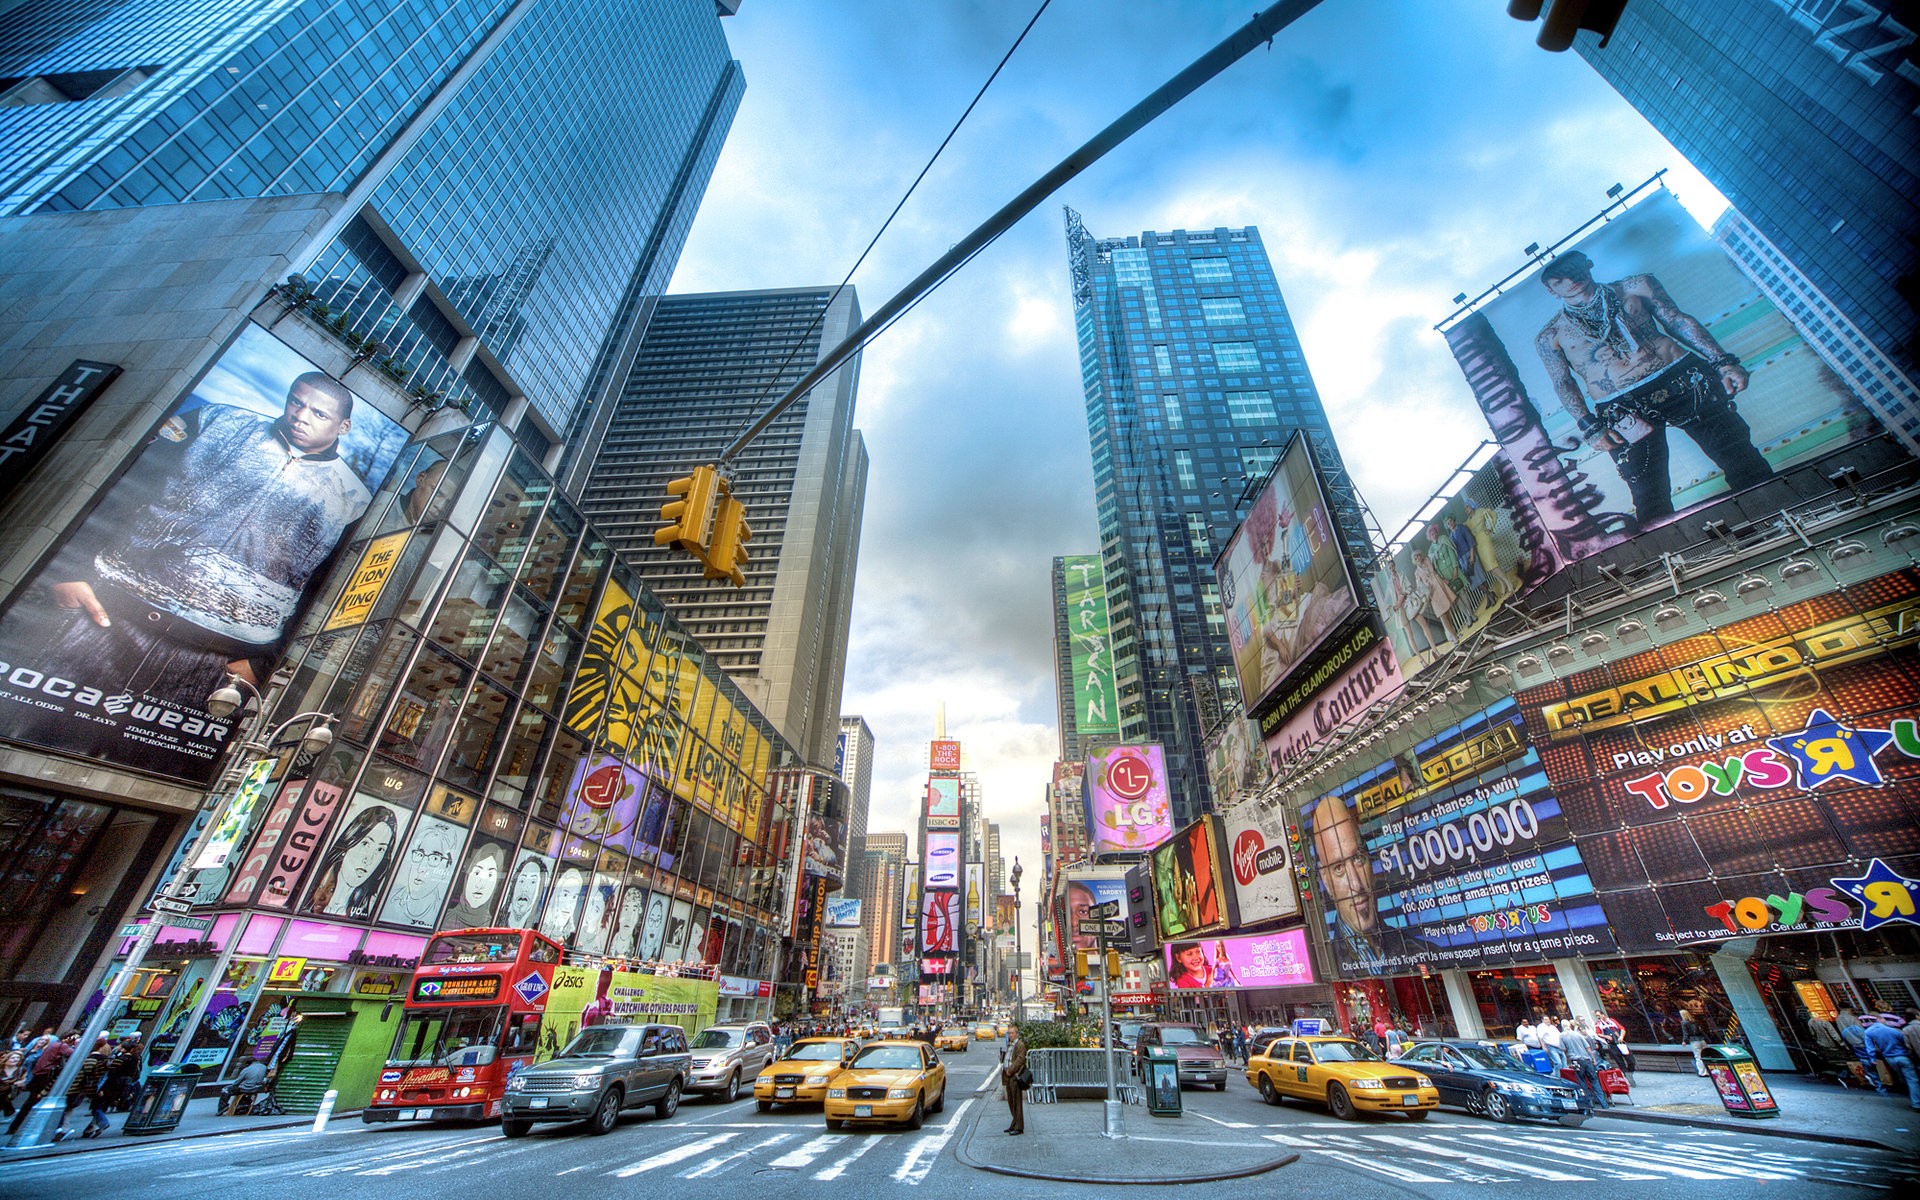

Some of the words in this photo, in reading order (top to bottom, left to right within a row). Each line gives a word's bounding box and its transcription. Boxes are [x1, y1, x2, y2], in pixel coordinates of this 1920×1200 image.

[370, 550, 393, 565] THE
[350, 567, 388, 592] LION
[336, 590, 375, 617] KING
[1070, 564, 1108, 723] TARZAN
[1262, 707, 1280, 733] BORN
[1279, 701, 1289, 717] IN
[1287, 690, 1302, 709] THE
[1301, 644, 1353, 697] GLAMOROUS
[1352, 626, 1374, 652] USA
[1313, 647, 1397, 737] Couture
[1554, 668, 1688, 731] DEAL
[1686, 664, 1716, 703] OR
[1706, 646, 1803, 690] NO
[11, 694, 34, 705] ALL
[35, 700, 65, 713] ODDS
[73, 710, 92, 720] DR.
[93, 716, 118, 727] JAYS
[125, 725, 158, 737] JIMMY
[157, 733, 179, 744] JAZZ
[186, 741, 218, 753] MACY'S
[143, 694, 158, 703] WE
[159, 700, 182, 711] RUN
[183, 706, 204, 717] THE
[204, 713, 234, 725] STRIP
[123, 732, 214, 760] WWW.ROCAWEAR.COM
[721, 720, 742, 753] THE
[1449, 727, 1518, 772] DEAL
[1612, 747, 1668, 770] Play
[1669, 732, 1723, 757] only
[1730, 723, 1759, 743] at
[683, 727, 719, 785] LION
[384, 776, 403, 790] we
[1625, 748, 1792, 810] TOYS
[1114, 802, 1153, 826] LG
[1381, 818, 1404, 837] Play
[1403, 812, 1420, 828] for
[1422, 811, 1430, 822] a
[1430, 796, 1475, 818] chance
[1474, 786, 1491, 802] to
[1491, 776, 1520, 794] win
[495, 817, 508, 828] all
[233, 786, 302, 893] PEACE
[267, 788, 336, 897] PEACE
[569, 845, 591, 858] speak
[1379, 797, 1539, 881] $1,000,000
[1236, 835, 1258, 879] Virgin
[1259, 850, 1283, 871] mobile
[1399, 889, 1409, 900] or
[1416, 881, 1433, 896] trip
[1434, 879, 1445, 890] to
[1446, 876, 1462, 889] the
[1463, 867, 1496, 883] show,
[1496, 865, 1508, 876] or
[1511, 857, 1537, 873] over
[1401, 897, 1436, 914] 100,000
[1438, 891, 1462, 907] other
[1465, 881, 1510, 901] amazing
[1511, 870, 1552, 893] prizes!
[157, 900, 169, 909] ONE
[174, 903, 187, 912] WAY
[815, 879, 826, 922] KODAK
[1703, 887, 1851, 933] TOYS
[172, 916, 208, 930] BROADWAY
[1084, 924, 1098, 932] ONE
[1424, 925, 1440, 939] Play
[1440, 923, 1458, 936] only
[1457, 922, 1466, 932] at
[1466, 913, 1507, 933] TOYS
[1655, 930, 1694, 942] Subject
[1694, 929, 1706, 938] to
[810, 925, 821, 968] digital
[1439, 946, 1482, 963] newspaper
[1483, 940, 1508, 956] insert
[1509, 939, 1523, 953] for
[1532, 936, 1562, 953] game
[1564, 930, 1599, 949] piece.
[275, 960, 297, 977] MTV
[443, 979, 478, 988] DOWNTOWN
[480, 979, 497, 987] LOOP
[475, 986, 495, 994] CENTER
[520, 982, 533, 992] GRAY
[533, 983, 544, 992] LINE
[613, 986, 645, 998] CHALLENGE:
[1120, 995, 1147, 1004] swatch
[614, 1002, 650, 1014] WATCHING
[650, 1003, 670, 1014] OTHERS
[670, 1003, 686, 1014] PASS
[686, 1003, 698, 1014] YOU
[397, 1068, 450, 1091] Broadway
